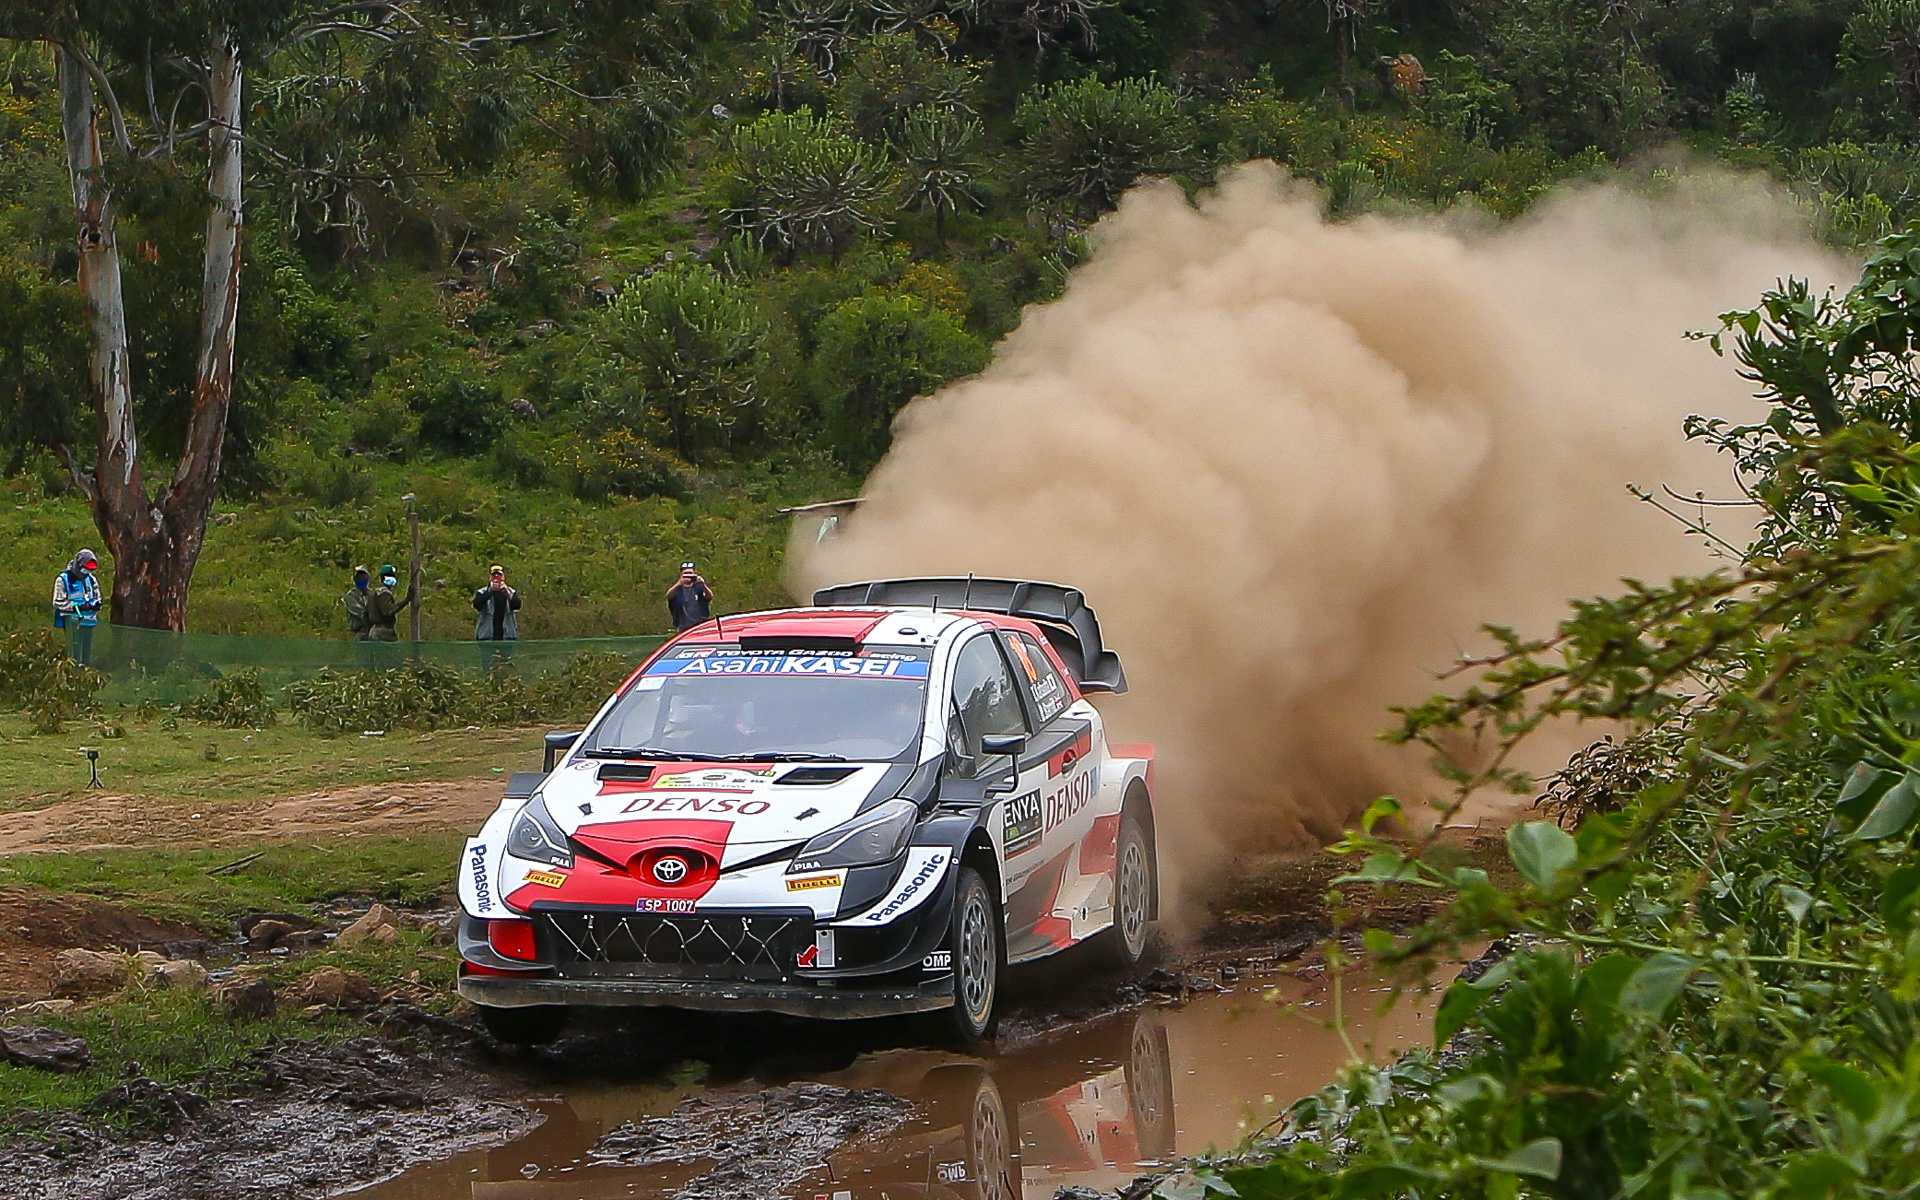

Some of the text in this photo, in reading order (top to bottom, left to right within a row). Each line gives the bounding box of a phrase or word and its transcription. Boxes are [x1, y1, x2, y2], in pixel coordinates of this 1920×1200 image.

[788, 649, 854, 657] GAZOO
[620, 798, 771, 815] DENSO
[1045, 770, 1089, 834] DENSO
[550, 856, 570, 867] PIAA
[794, 861, 821, 871] PIAA
[469, 844, 497, 913] Panasonic
[529, 871, 563, 885] PIRELLI
[788, 876, 838, 889] PIRELLI
[866, 853, 945, 921] Panasonic
[645, 901, 694, 912] SP 1007
[922, 955, 951, 968] OMP
